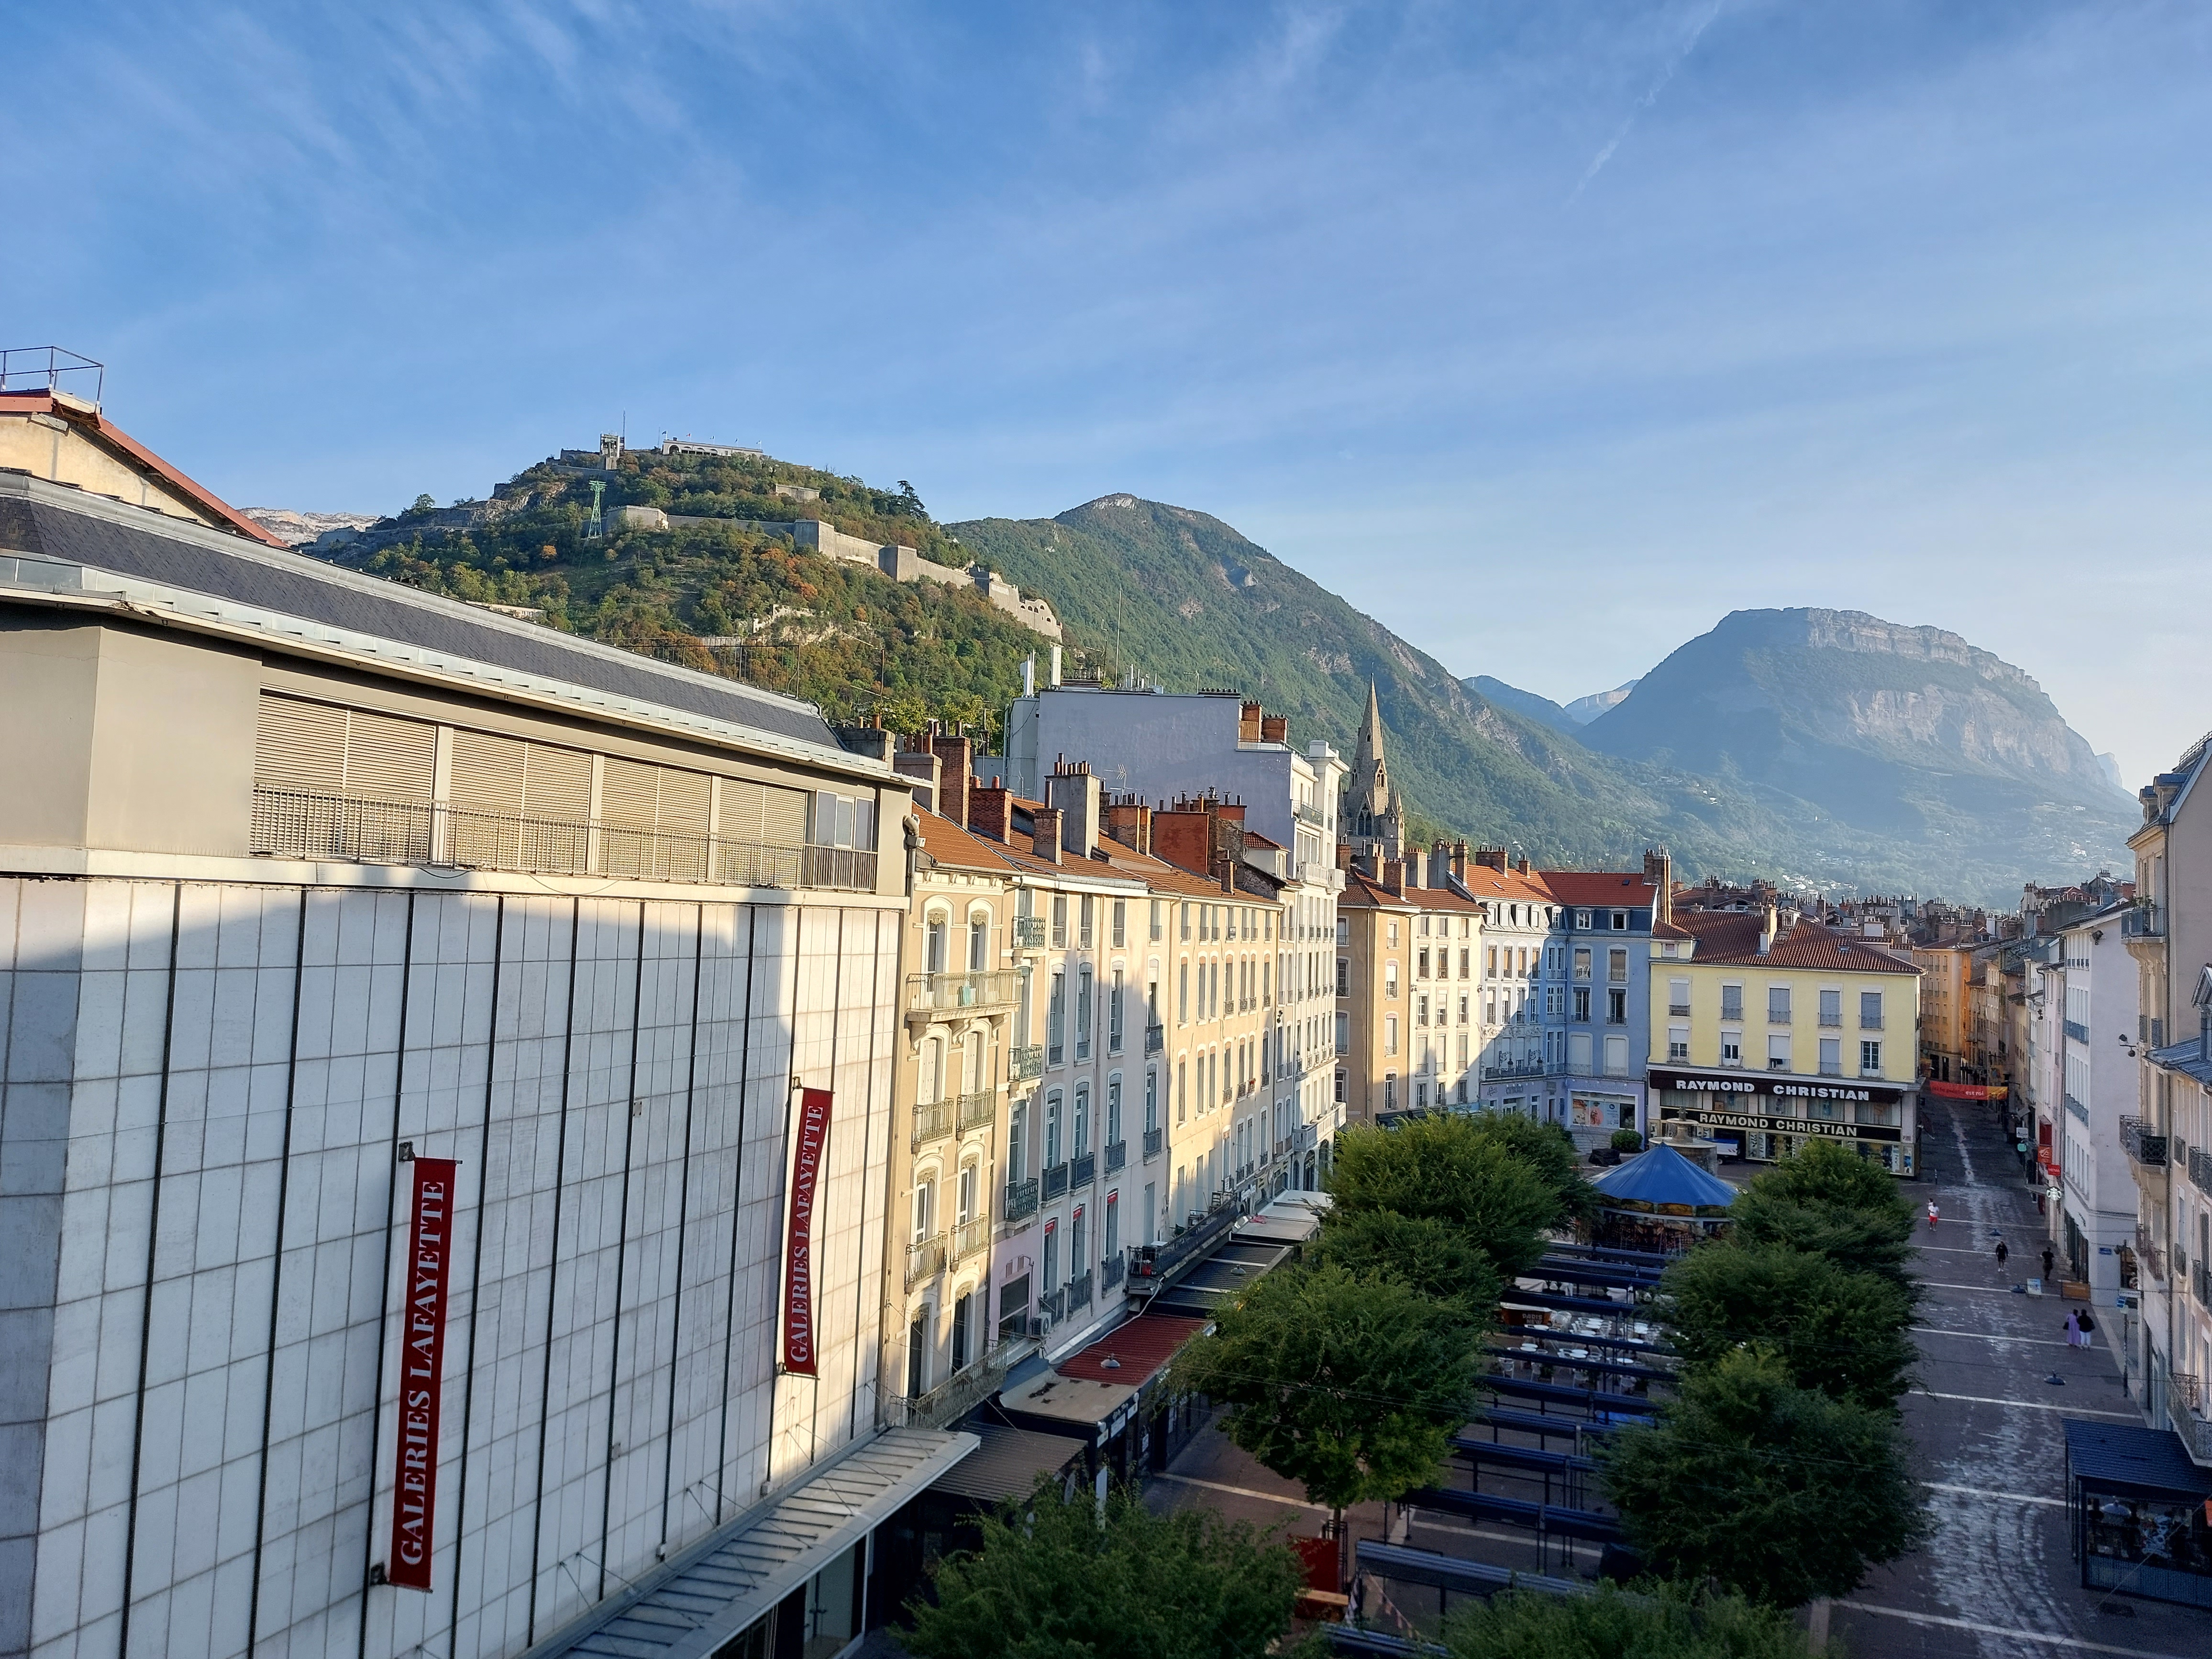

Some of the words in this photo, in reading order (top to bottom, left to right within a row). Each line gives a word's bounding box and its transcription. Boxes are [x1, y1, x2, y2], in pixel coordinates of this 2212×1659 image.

[1676, 1080, 1755, 1092] RAYMOND
[1773, 1085, 1869, 1101] CHRISTIAN
[1700, 1113, 1769, 1128] RAYMOND
[1776, 1120, 1857, 1137] CHRISTIAN
[795, 1106, 824, 1239] LAFAYETTE
[410, 1181, 444, 1380] LAFAYETTE
[791, 1246, 808, 1362] GALERIES
[401, 1390, 431, 1566] GALERIES
